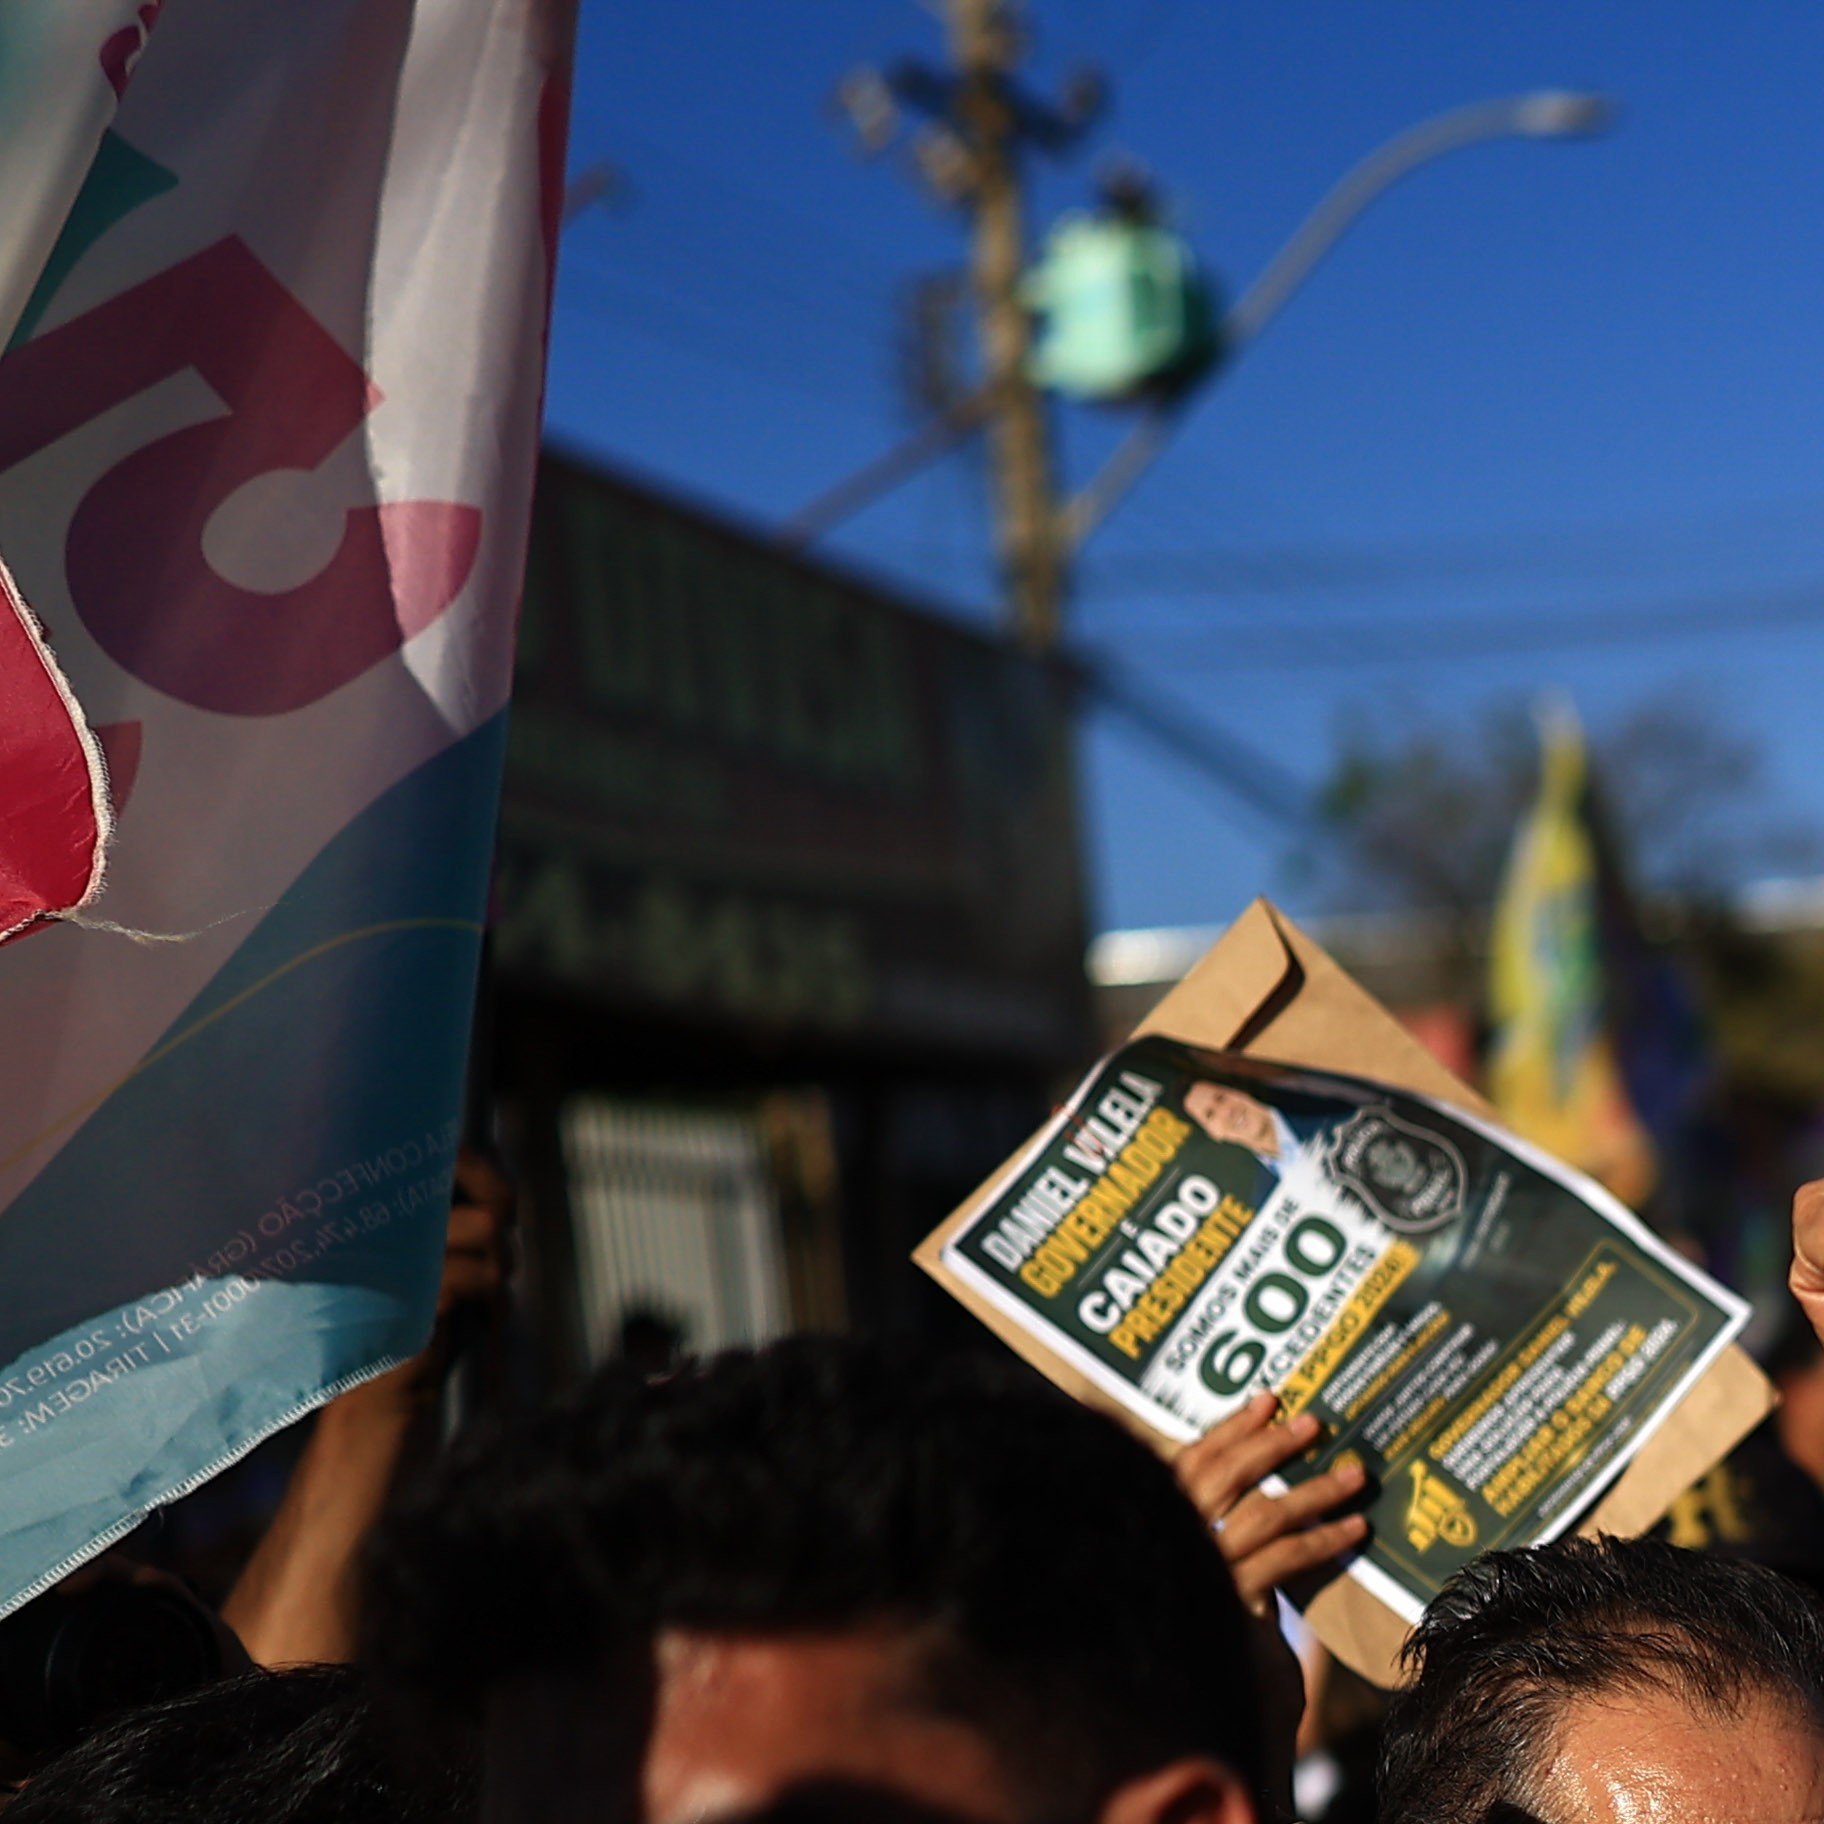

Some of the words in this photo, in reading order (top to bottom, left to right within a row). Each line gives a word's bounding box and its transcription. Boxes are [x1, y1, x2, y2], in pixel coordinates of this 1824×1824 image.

[979, 1165, 1089, 1271] DANIEL
[1061, 1073, 1164, 1176] VILELA
[1016, 1105, 1193, 1297] GOVERNADOR
[1078, 1176, 1221, 1334] CAIADO
[1105, 1194, 1255, 1357] PRESIDENTE
[1165, 1288, 1238, 1374] SOMOS
[1232, 1226, 1279, 1281] MAIS
[1273, 1198, 1298, 1226] DE
[1198, 1212, 1348, 1396] 600
[1254, 1245, 1376, 1391] XCEDENTES
[1425, 1361, 1525, 1461] GOVERNADOR
[1515, 1311, 1572, 1368] DANIEL
[1478, 1421, 1557, 1504] AMPLIAR
